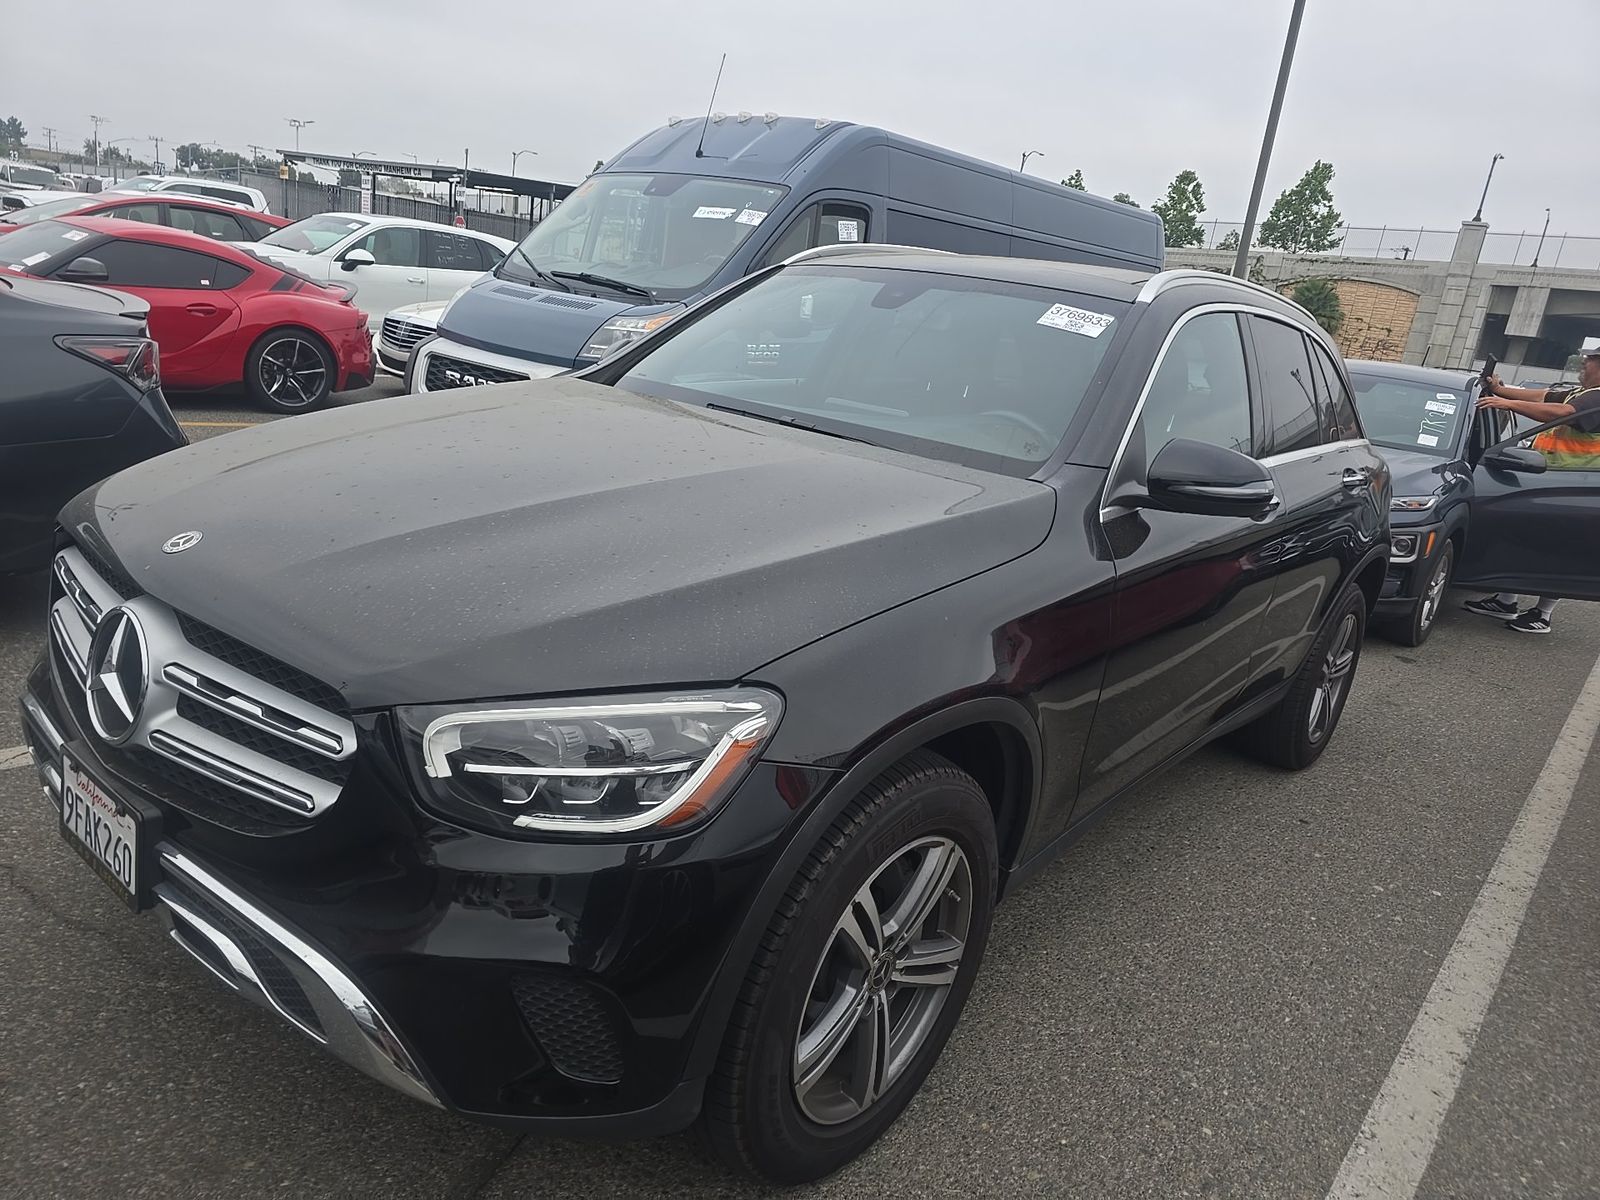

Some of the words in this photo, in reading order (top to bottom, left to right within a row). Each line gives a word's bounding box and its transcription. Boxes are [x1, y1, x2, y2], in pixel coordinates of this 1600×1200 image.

[313, 158, 330, 167] THANK
[331, 160, 342, 168] YOU
[343, 161, 354, 170] FOR
[355, 162, 383, 172] CHOOSING
[384, 165, 412, 175] MANHEIM
[413, 168, 422, 176] CA
[1050, 306, 1111, 328] 3769833
[65, 785, 132, 888] 9FAK260
